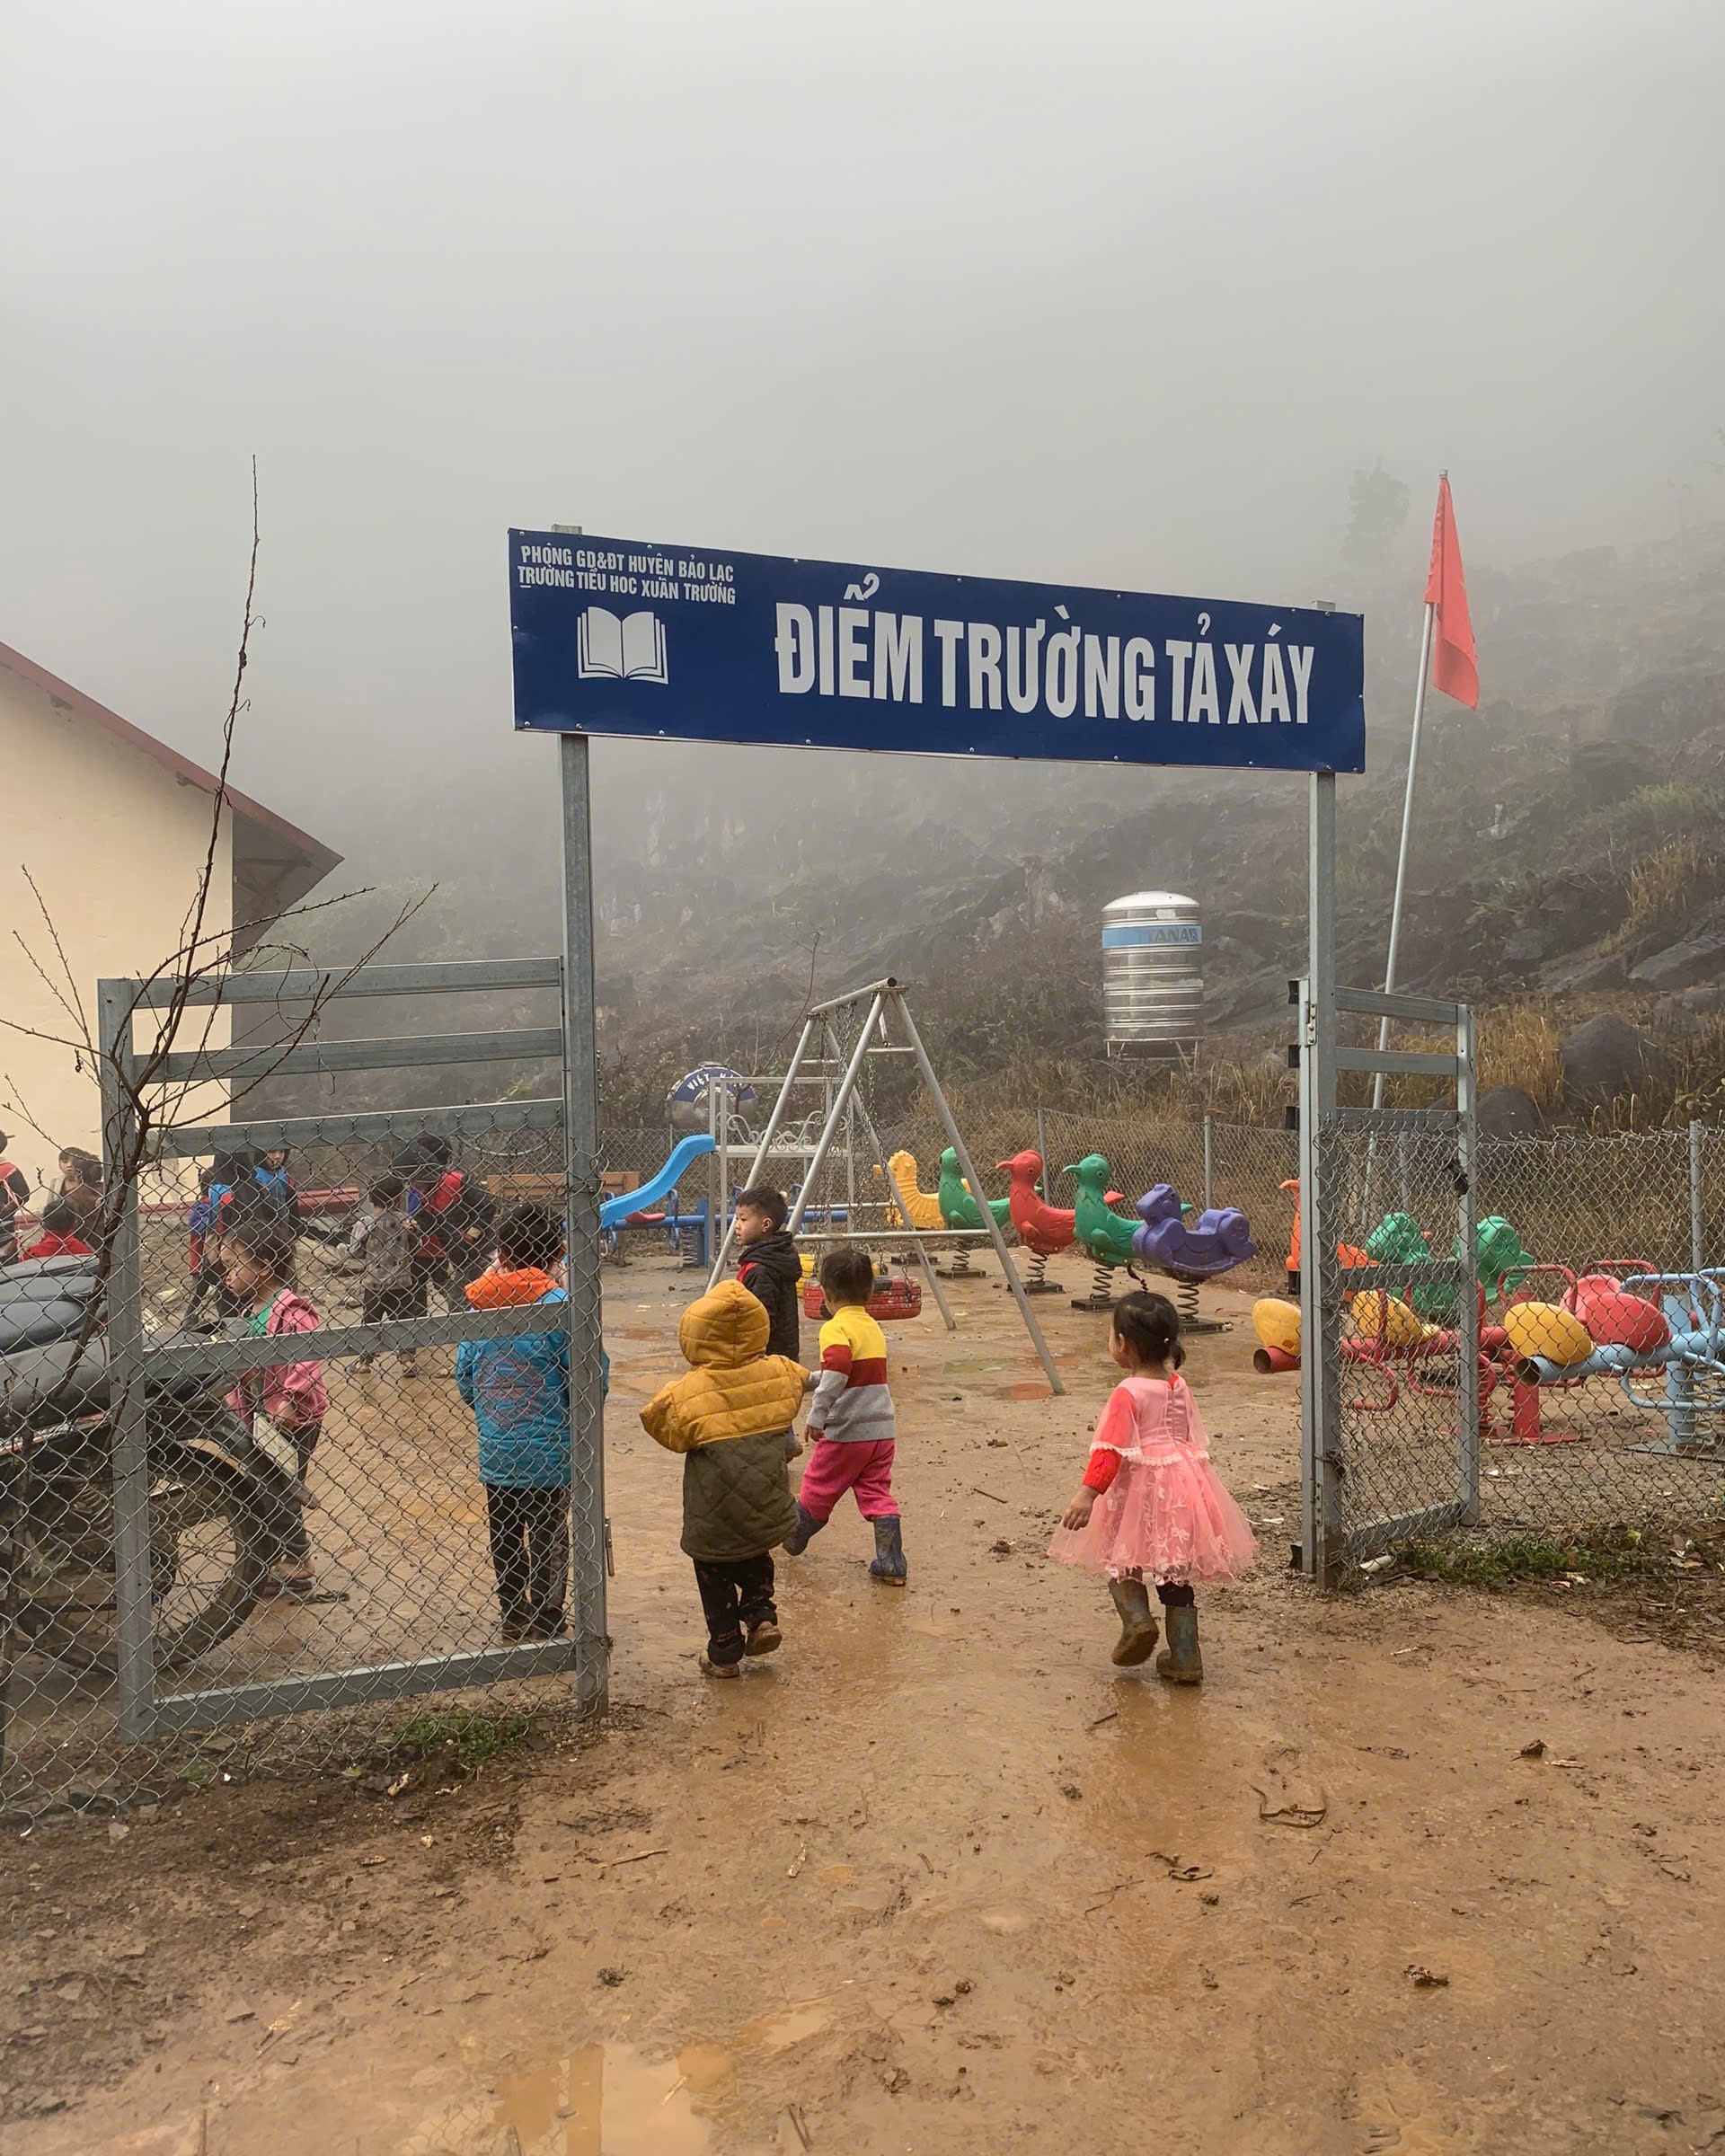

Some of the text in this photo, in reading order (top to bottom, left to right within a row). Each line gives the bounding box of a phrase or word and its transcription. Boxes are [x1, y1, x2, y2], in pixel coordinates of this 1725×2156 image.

[518, 564, 575, 588] TRƯỜNG
[576, 568, 606, 590] TIỂU
[684, 581, 736, 605] TRƯỜNG
[576, 550, 624, 571] GD&ĐT
[678, 554, 705, 579] BẢO
[774, 572, 1315, 725] ĐIỂM TRƯỜNG TẢ XÁY
